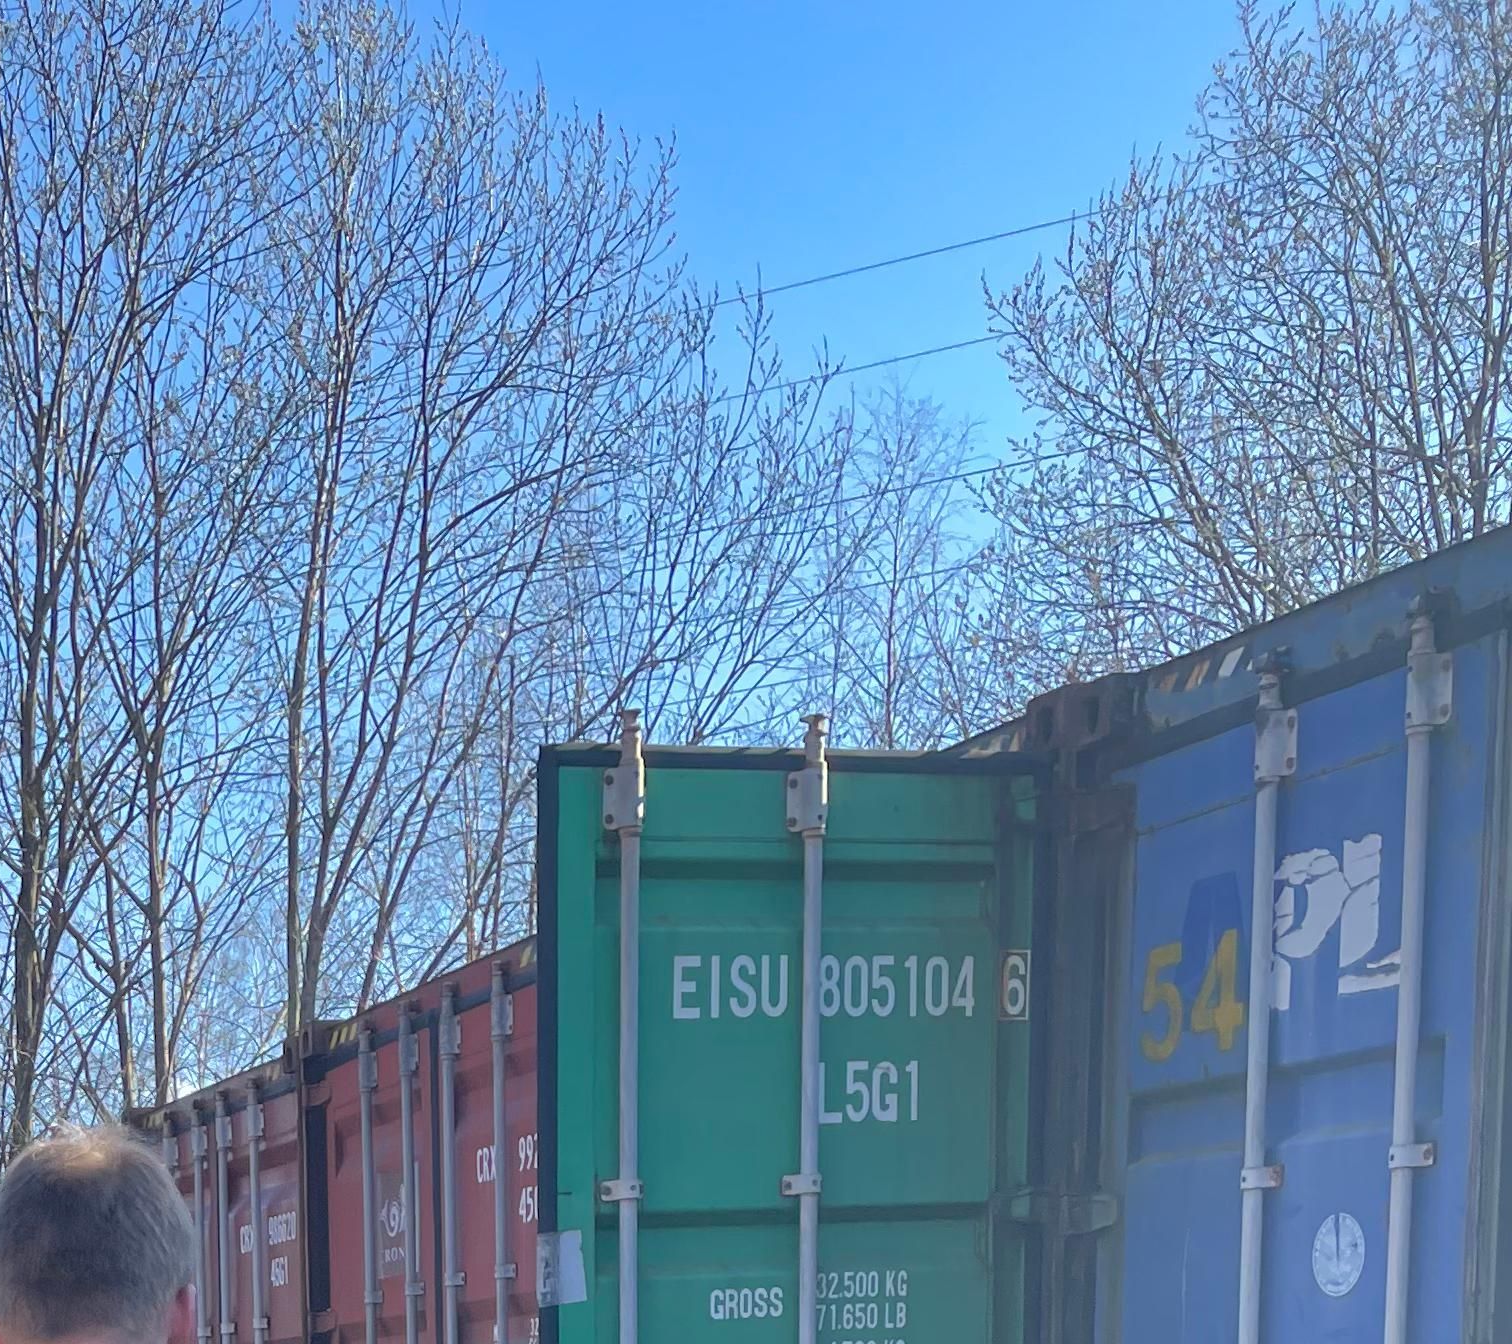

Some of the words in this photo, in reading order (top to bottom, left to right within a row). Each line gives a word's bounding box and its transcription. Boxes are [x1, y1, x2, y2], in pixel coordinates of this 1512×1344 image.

[672, 954, 789, 1020] EISU
[819, 954, 976, 1018] 805104
[1002, 953, 1029, 1018] 6
[1141, 928, 1244, 1063] 54
[819, 1059, 920, 1124] L5G1
[476, 1145, 497, 1183] CRX
[815, 1271, 879, 1299] 32.500
[885, 1270, 908, 1297] KG
[709, 1287, 784, 1321] GROSS
[815, 1303, 878, 1331] 71.650
[884, 1301, 906, 1328] LB
